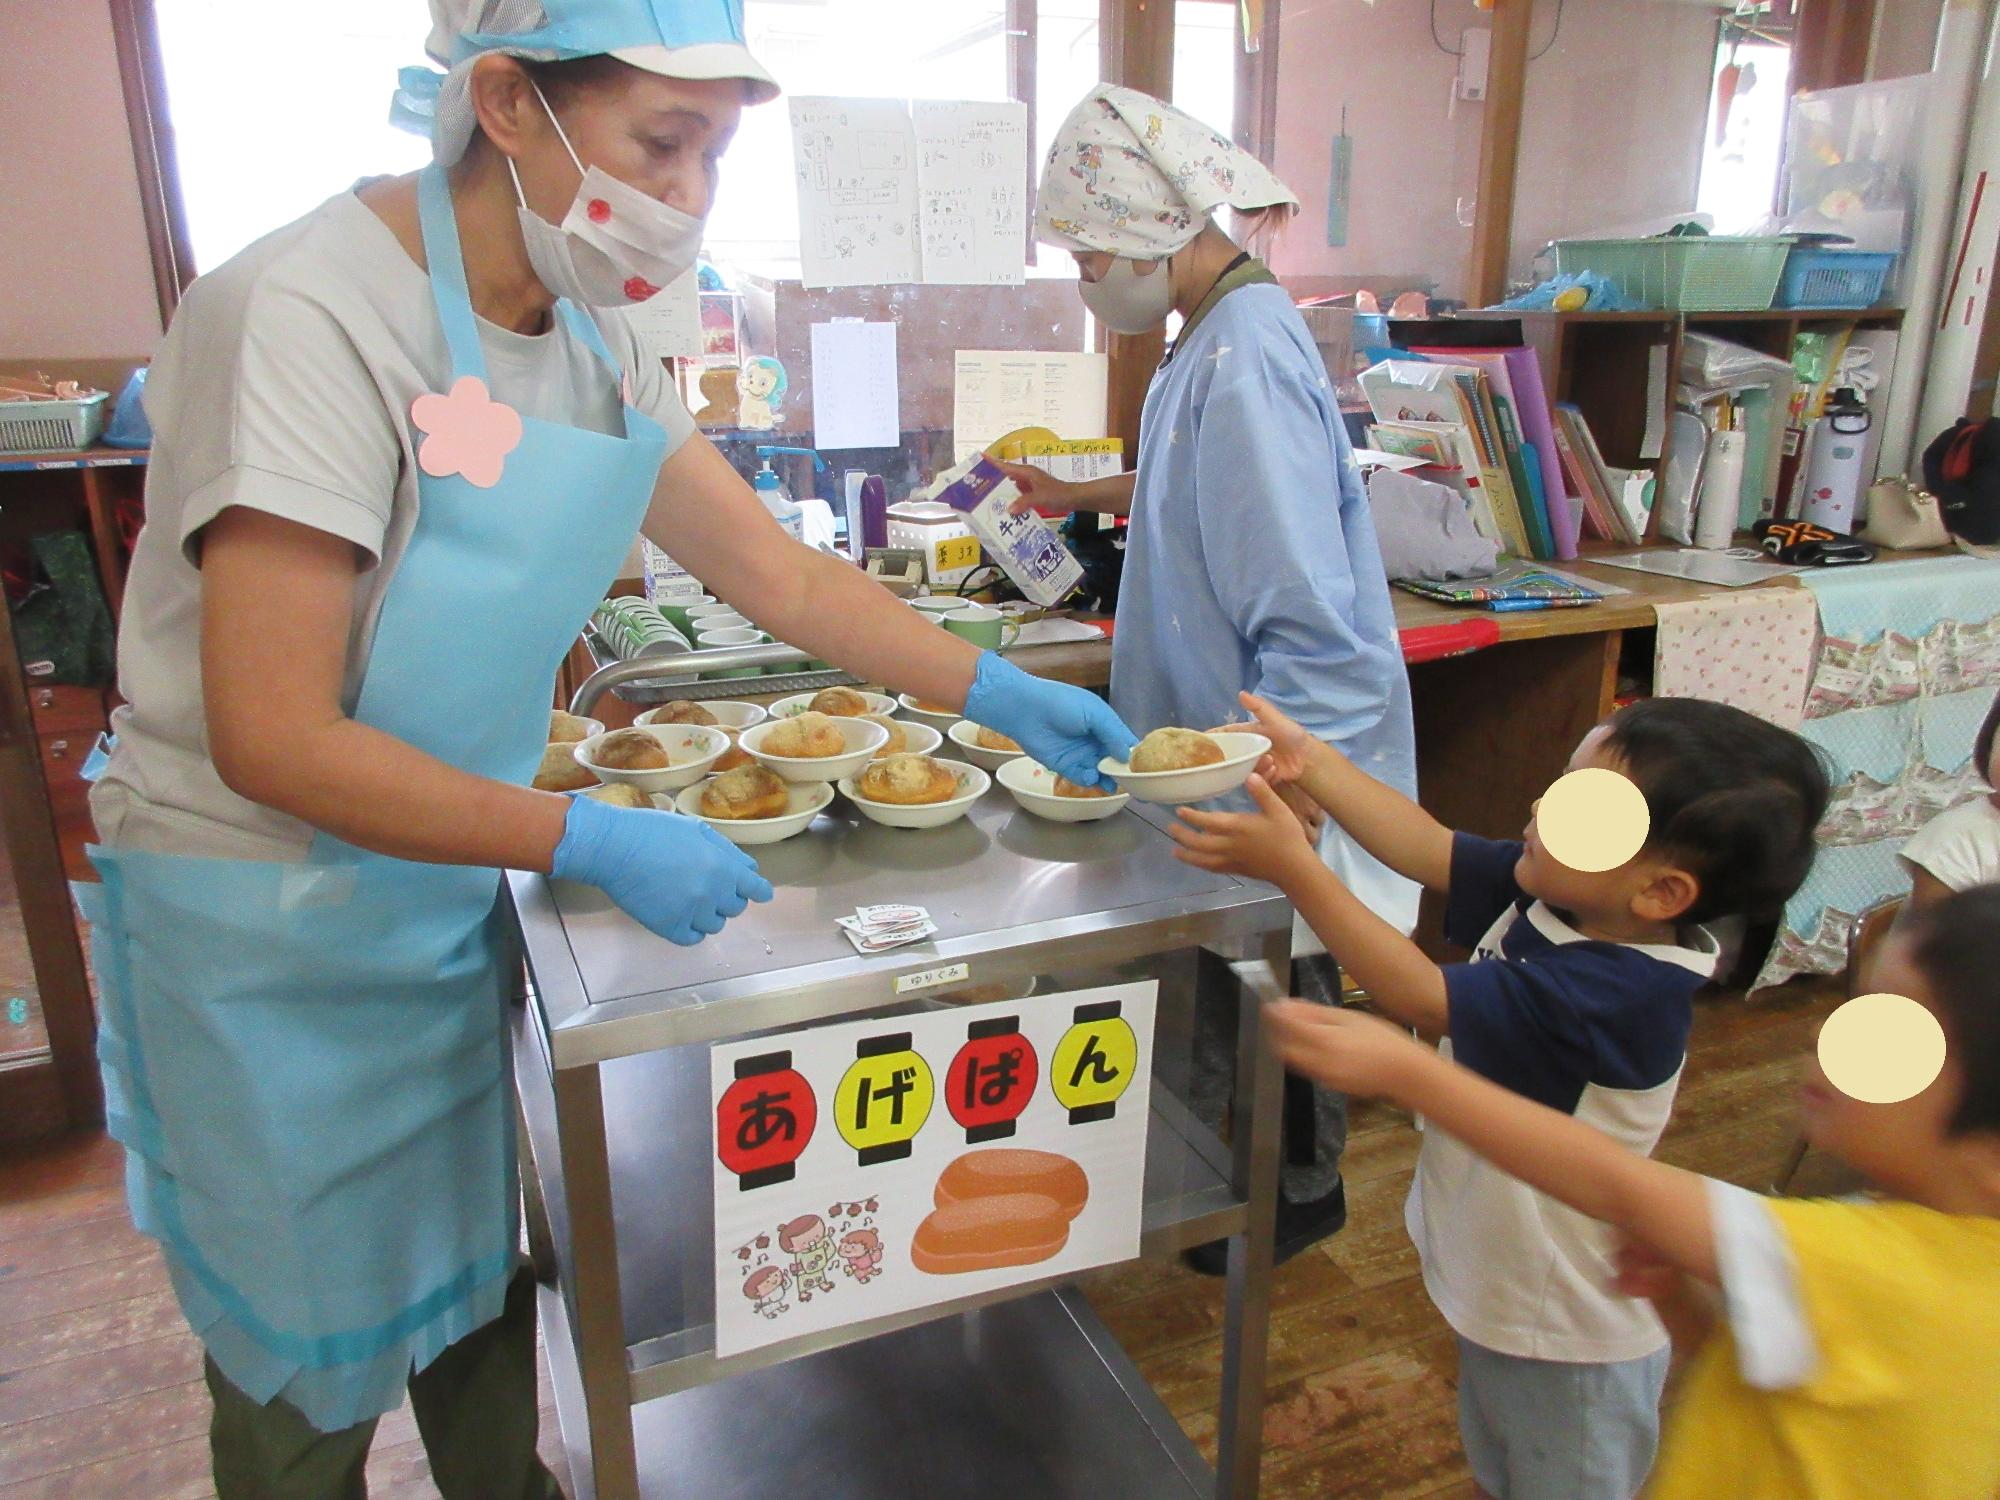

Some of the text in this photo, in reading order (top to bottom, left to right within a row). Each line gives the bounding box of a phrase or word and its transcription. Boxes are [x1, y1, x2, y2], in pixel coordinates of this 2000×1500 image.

[999, 511, 1031, 537] 牛乳
[736, 1035, 1120, 1150] あげぱん
